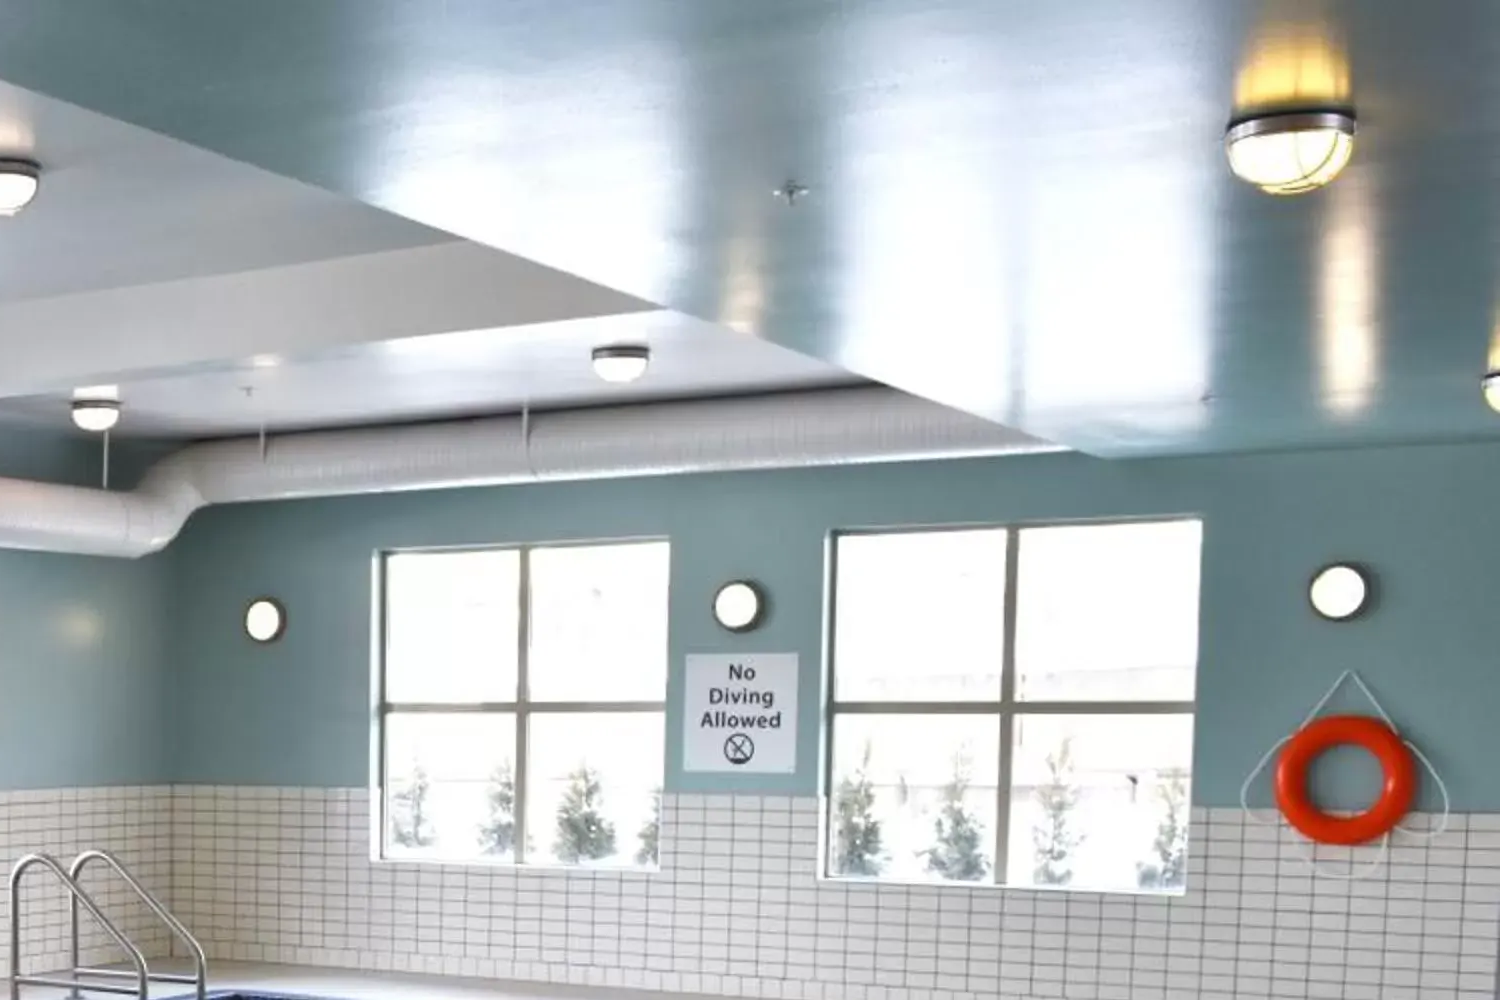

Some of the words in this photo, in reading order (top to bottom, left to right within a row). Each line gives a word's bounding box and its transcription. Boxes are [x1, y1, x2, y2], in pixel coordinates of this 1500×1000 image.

[729, 664, 756, 680] No
[709, 688, 774, 708] Diving
[701, 711, 781, 728] Allowed
